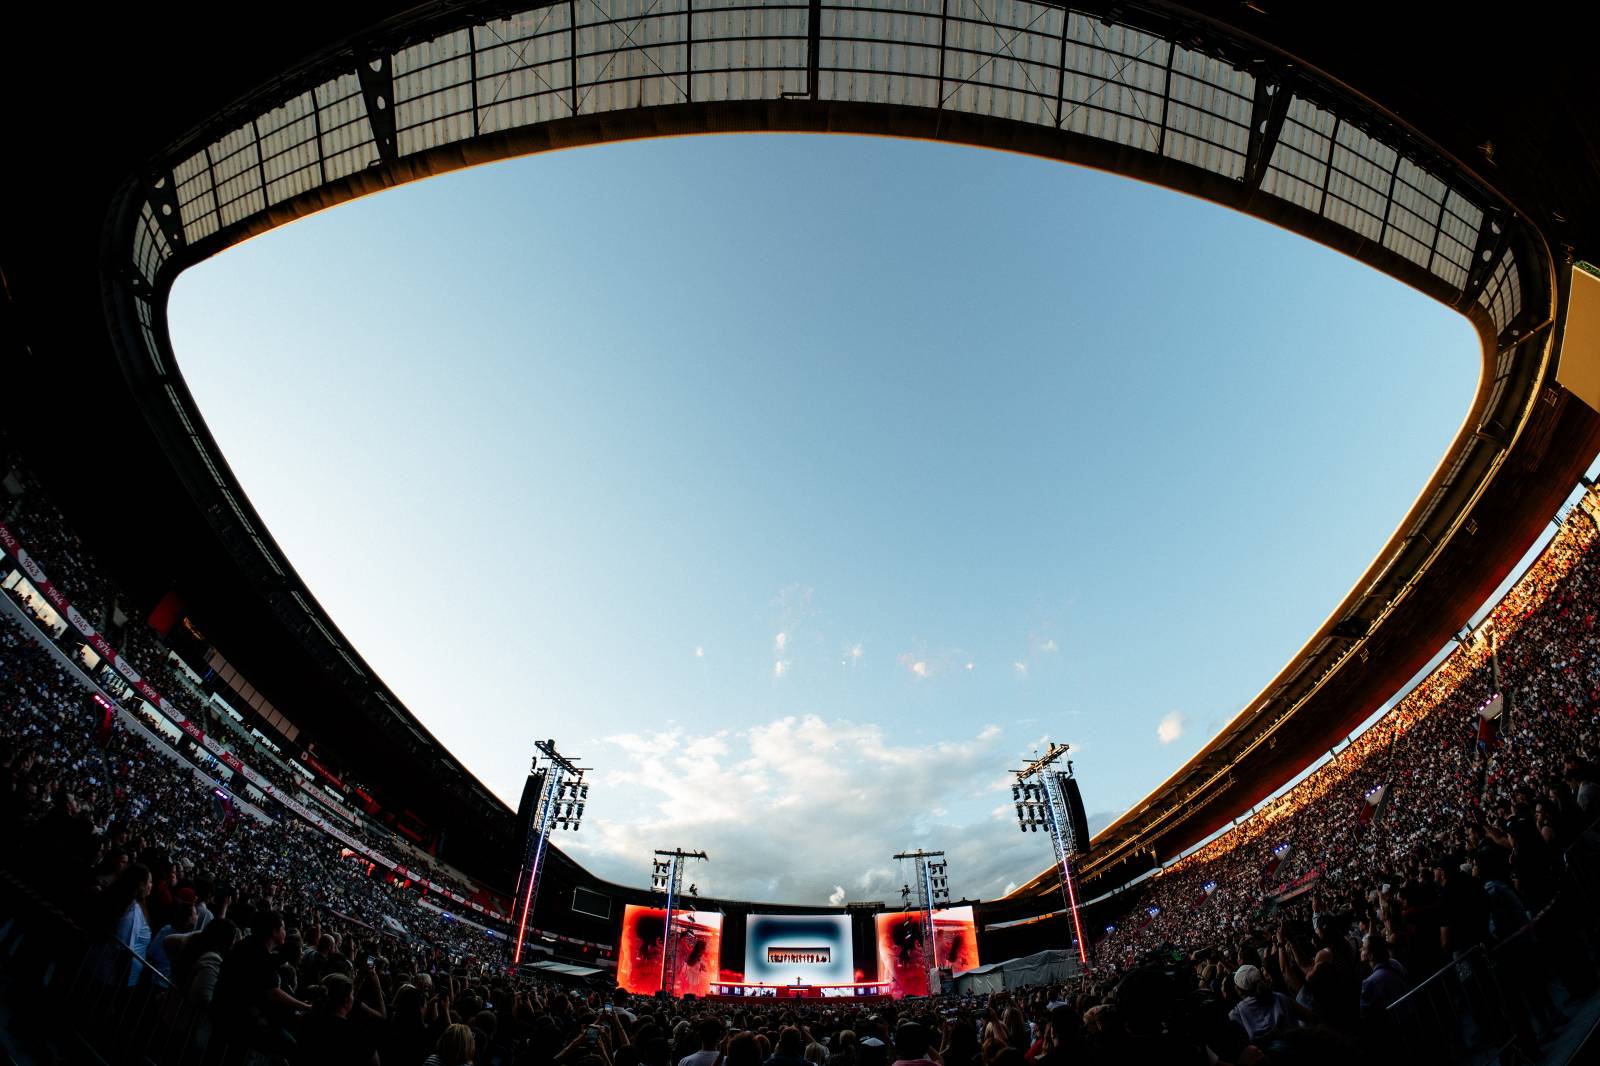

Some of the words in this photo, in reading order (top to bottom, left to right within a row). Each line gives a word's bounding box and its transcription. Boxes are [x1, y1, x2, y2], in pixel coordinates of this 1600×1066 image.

[0, 527, 15, 548] 1942
[23, 557, 40, 577] 1943
[73, 614, 88, 631] 1945
[96, 639, 111, 656] 1974
[227, 754, 240, 768] 2021
